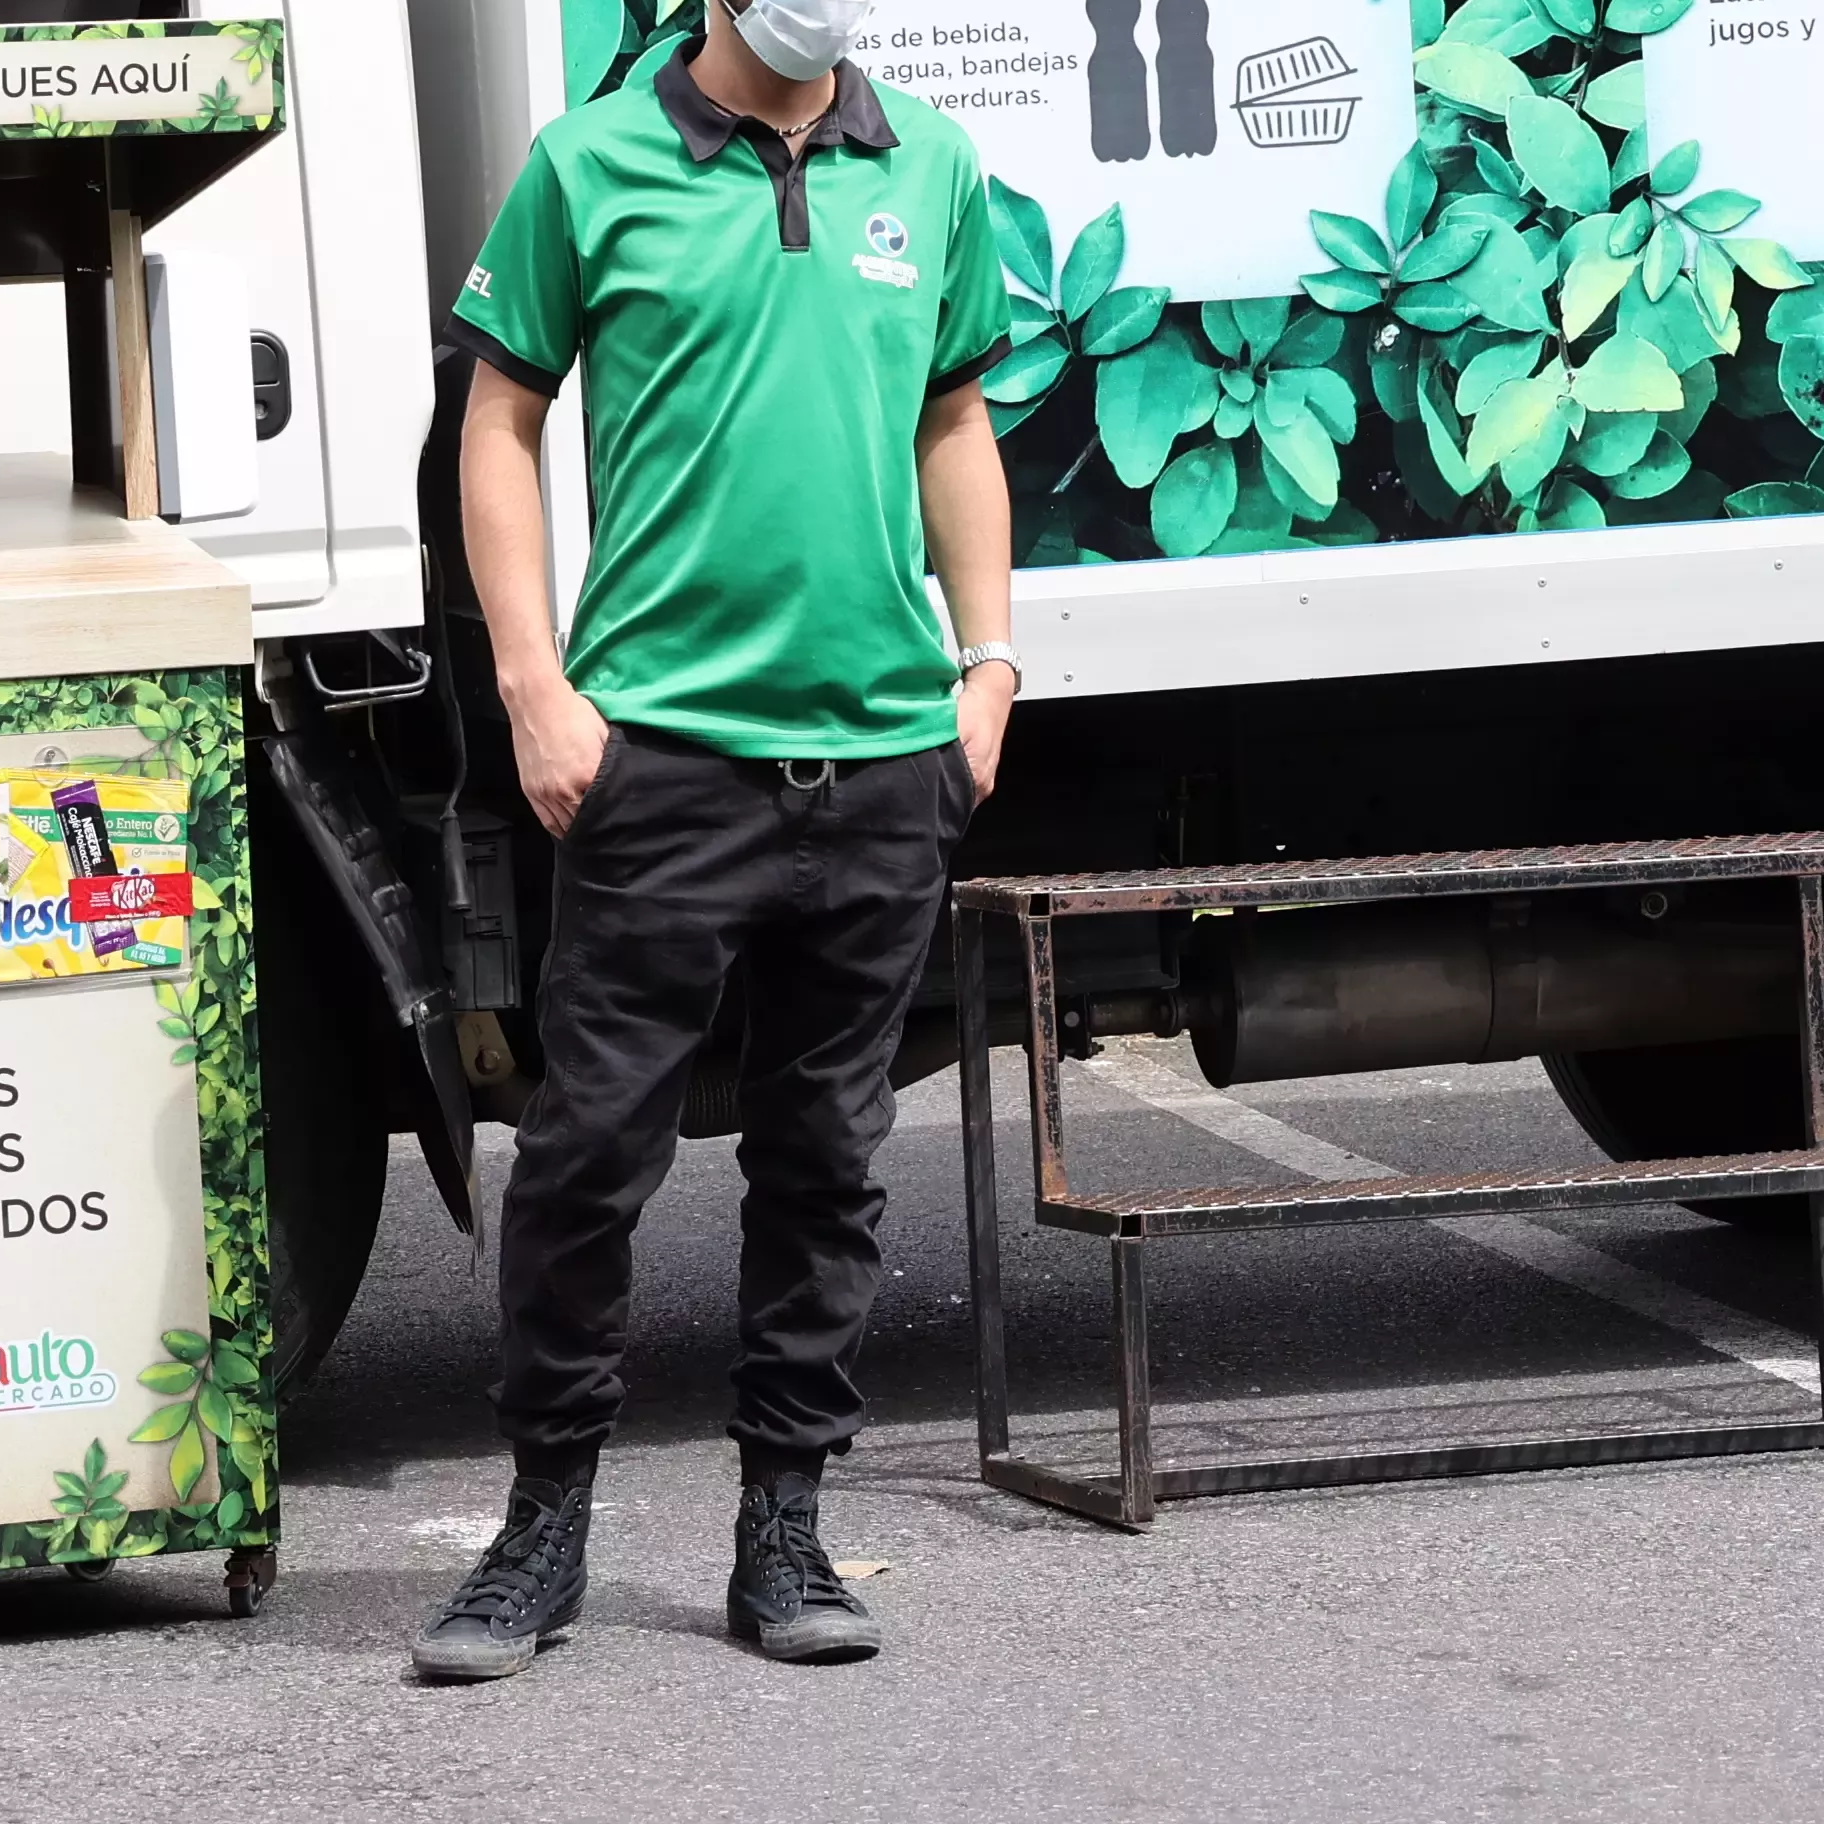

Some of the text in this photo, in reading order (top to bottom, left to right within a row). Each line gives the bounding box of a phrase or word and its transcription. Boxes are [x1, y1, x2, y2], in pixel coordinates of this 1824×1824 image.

[891, 27, 923, 48] de
[933, 21, 1029, 46] bebida,
[1707, 16, 1790, 47] jugos
[1799, 20, 1816, 40] y
[90, 53, 191, 96] AQUÍ
[882, 61, 953, 84] agua,
[962, 52, 1078, 77] bandejas
[931, 87, 1049, 111] verduras.
[116, 817, 153, 830] Entero
[112, 878, 155, 909] KitKat
